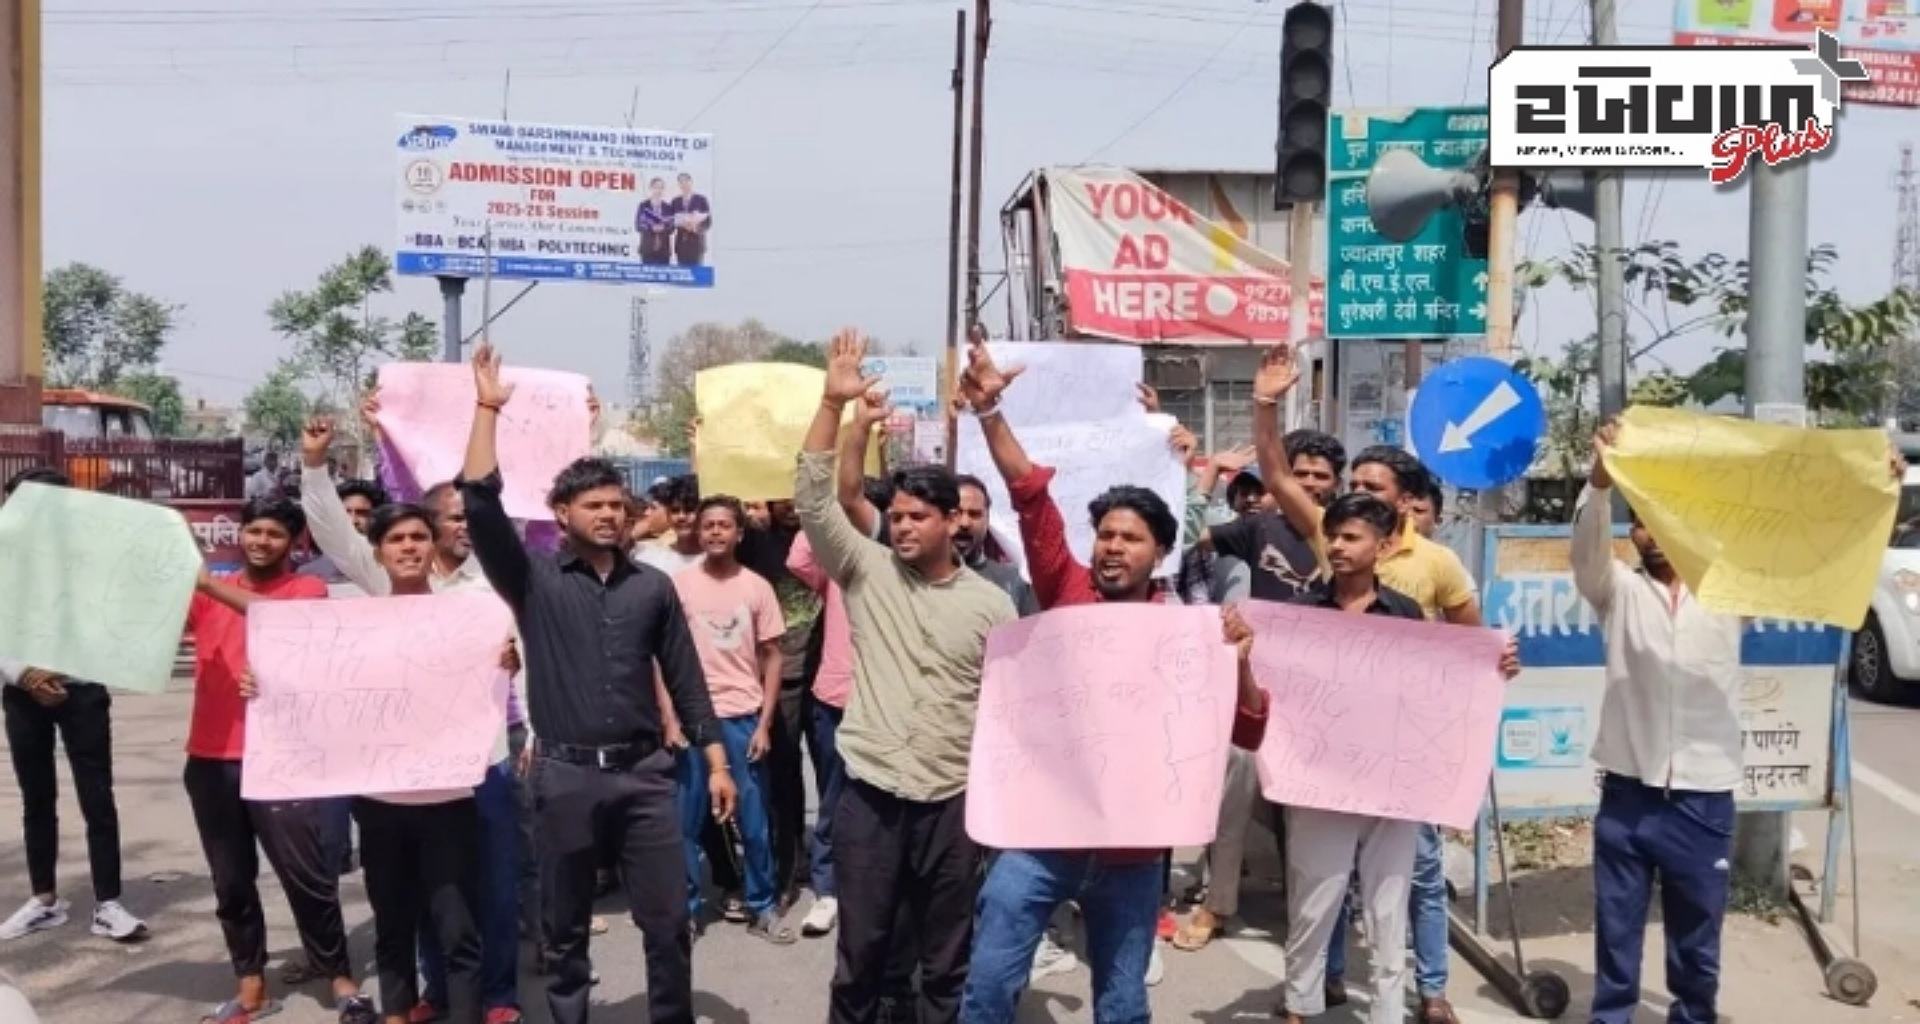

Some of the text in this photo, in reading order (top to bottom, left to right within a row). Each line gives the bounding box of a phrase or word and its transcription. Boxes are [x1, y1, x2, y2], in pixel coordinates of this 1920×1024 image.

[495, 140, 582, 154] MANAGEMENT
[602, 146, 685, 161] TECHNOLOGY
[622, 133, 689, 148] INSTITUTE
[449, 162, 571, 187] ADMISSION
[580, 171, 635, 190] OPEN
[530, 189, 555, 201] FOR
[1341, 182, 1367, 206] हरि
[487, 202, 599, 220] 2025-26 Session
[415, 234, 631, 257] BBA BCA MBA POLYTECHNIC
[1113, 233, 1170, 270] AD
[1340, 245, 1446, 270] ज्वालापुर शहर
[1092, 278, 1199, 321] HERE
[1394, 297, 1417, 321] देवी
